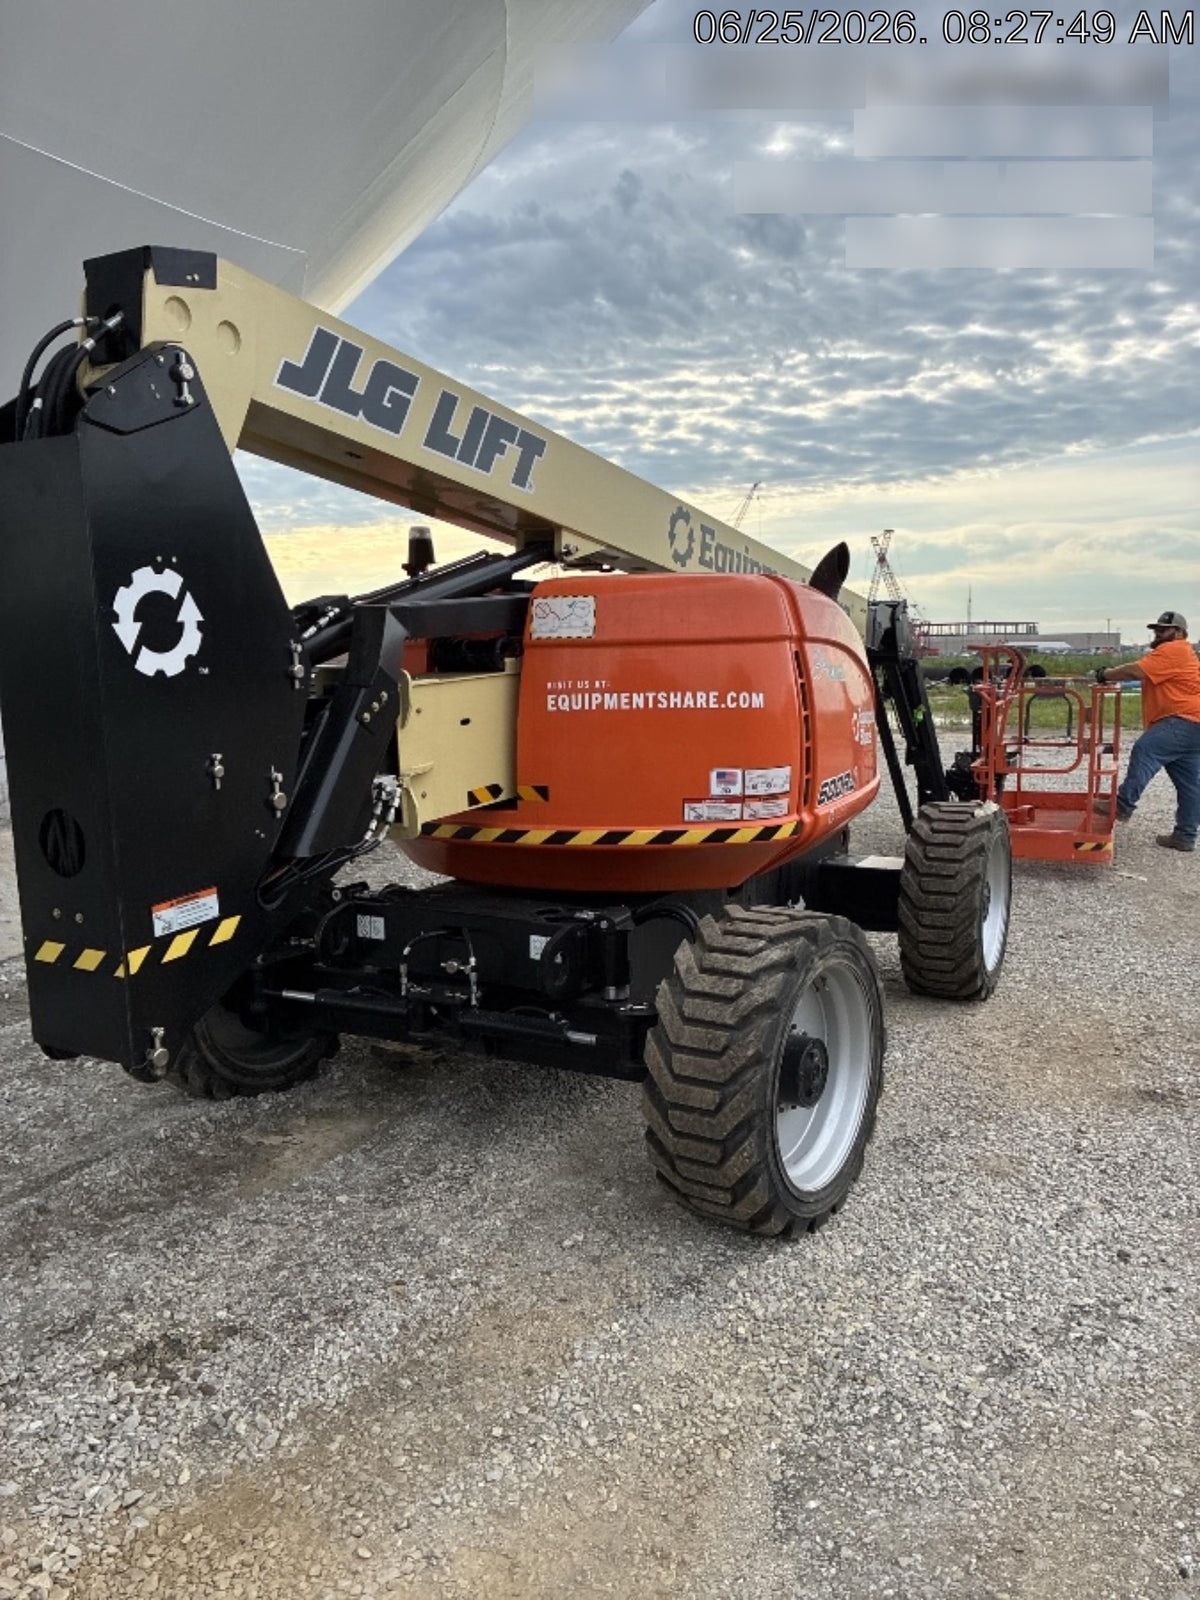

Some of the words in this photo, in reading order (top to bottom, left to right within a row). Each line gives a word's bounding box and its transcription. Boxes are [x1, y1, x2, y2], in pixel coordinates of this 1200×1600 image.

[273, 325, 422, 438] JLG
[421, 388, 548, 494] LIFT
[577, 680, 590, 689] US
[546, 691, 765, 712] EQUIPMENTSHARE.COM
